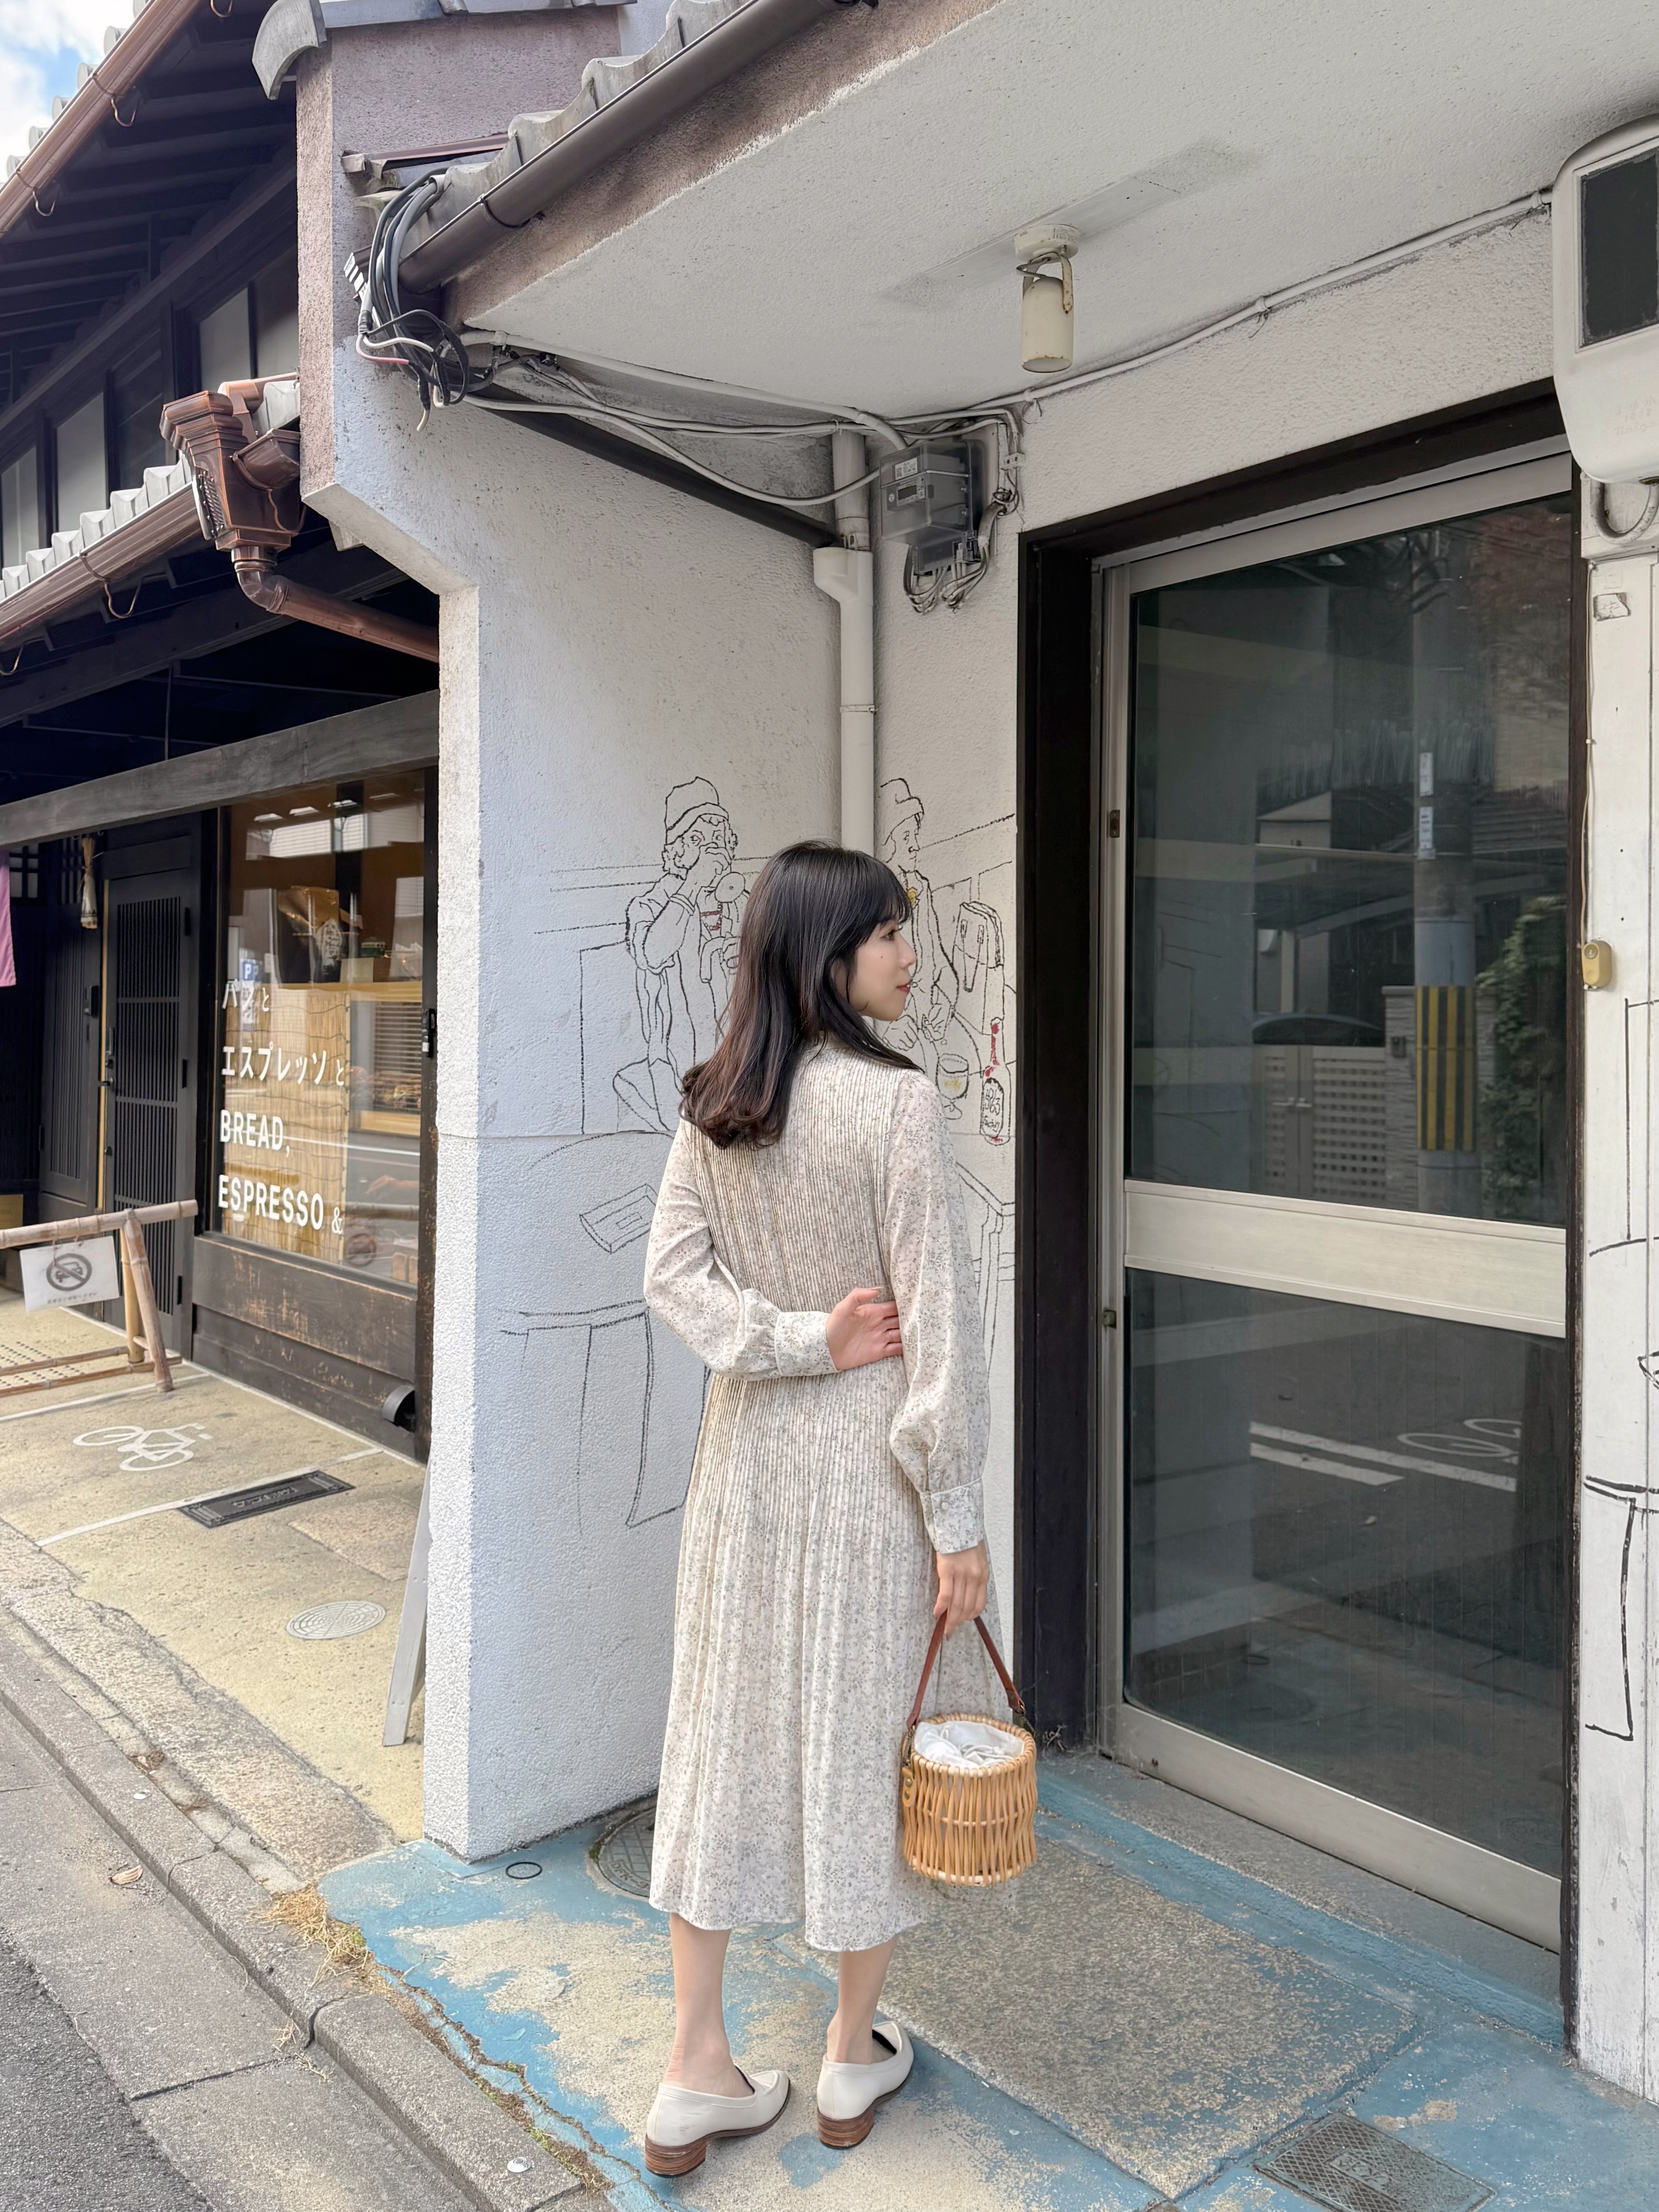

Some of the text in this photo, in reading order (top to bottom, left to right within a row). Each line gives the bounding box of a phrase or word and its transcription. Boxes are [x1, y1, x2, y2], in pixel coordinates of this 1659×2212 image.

[222, 1041, 344, 1086] エスプレッソと
[220, 1109, 290, 1157] BREAD,
[218, 1174, 343, 1234] ESPRESSO &
